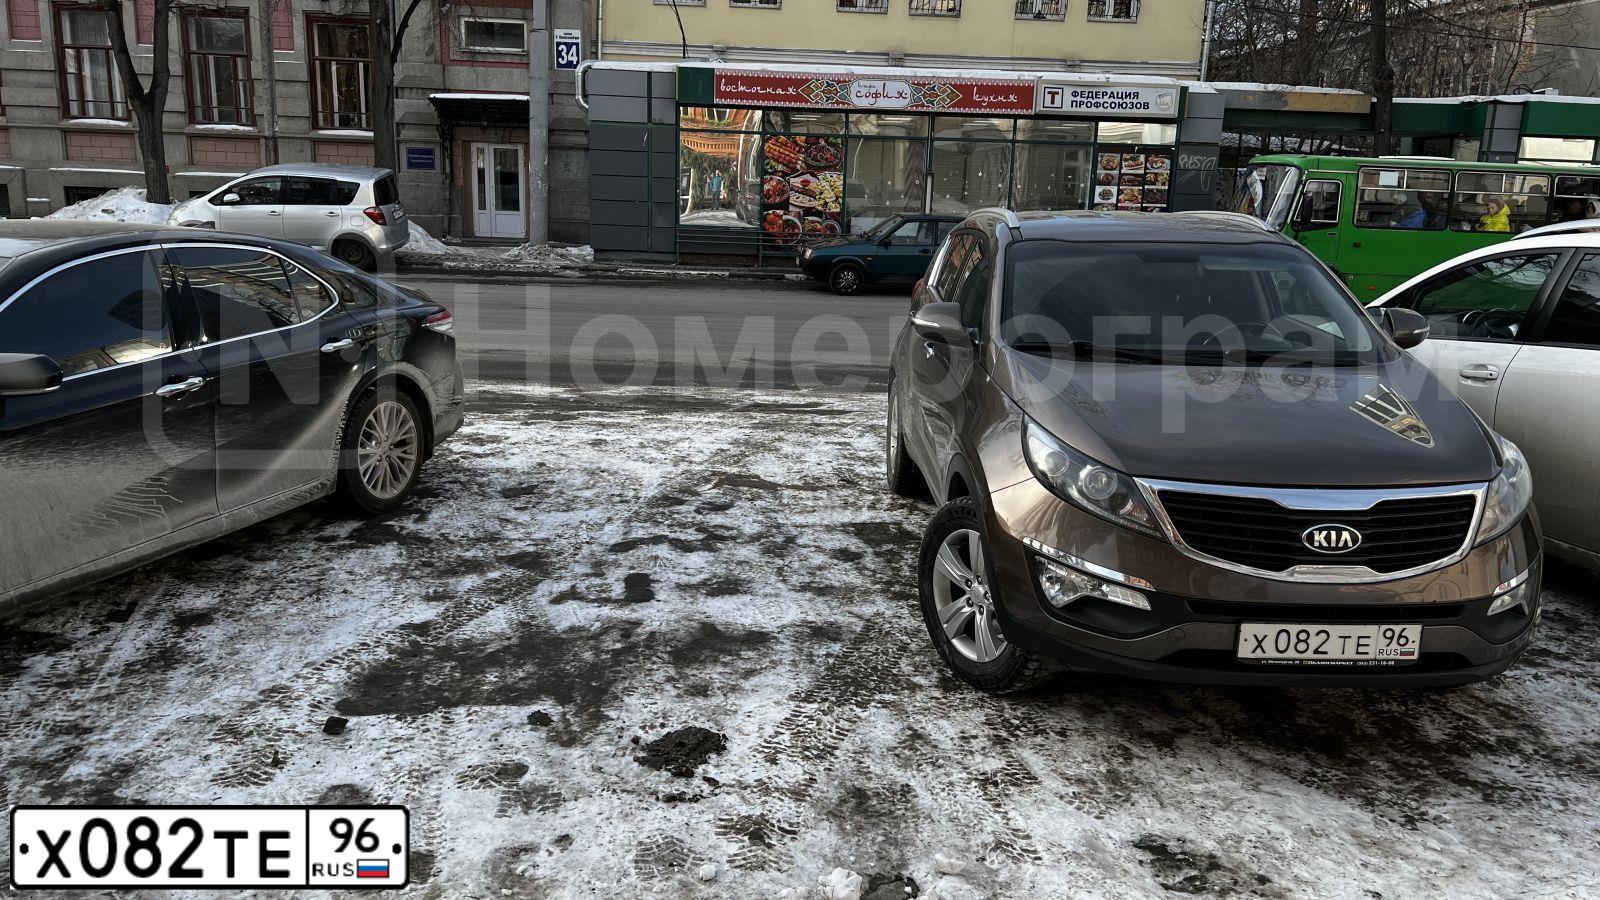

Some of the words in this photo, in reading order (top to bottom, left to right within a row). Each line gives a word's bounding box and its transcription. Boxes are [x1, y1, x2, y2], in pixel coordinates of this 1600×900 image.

[558, 44, 578, 65] 34
[720, 78, 797, 94] восточная
[855, 82, 908, 105] софия
[973, 86, 1018, 105] кухня
[1071, 90, 1139, 100] ФЕДЕРАЦИЯ
[1071, 100, 1150, 110] ПРОФСОЮЗОВ
[1313, 531, 1353, 547] KIA
[1383, 628, 1409, 647] 96
[1378, 648, 1399, 657] RUS
